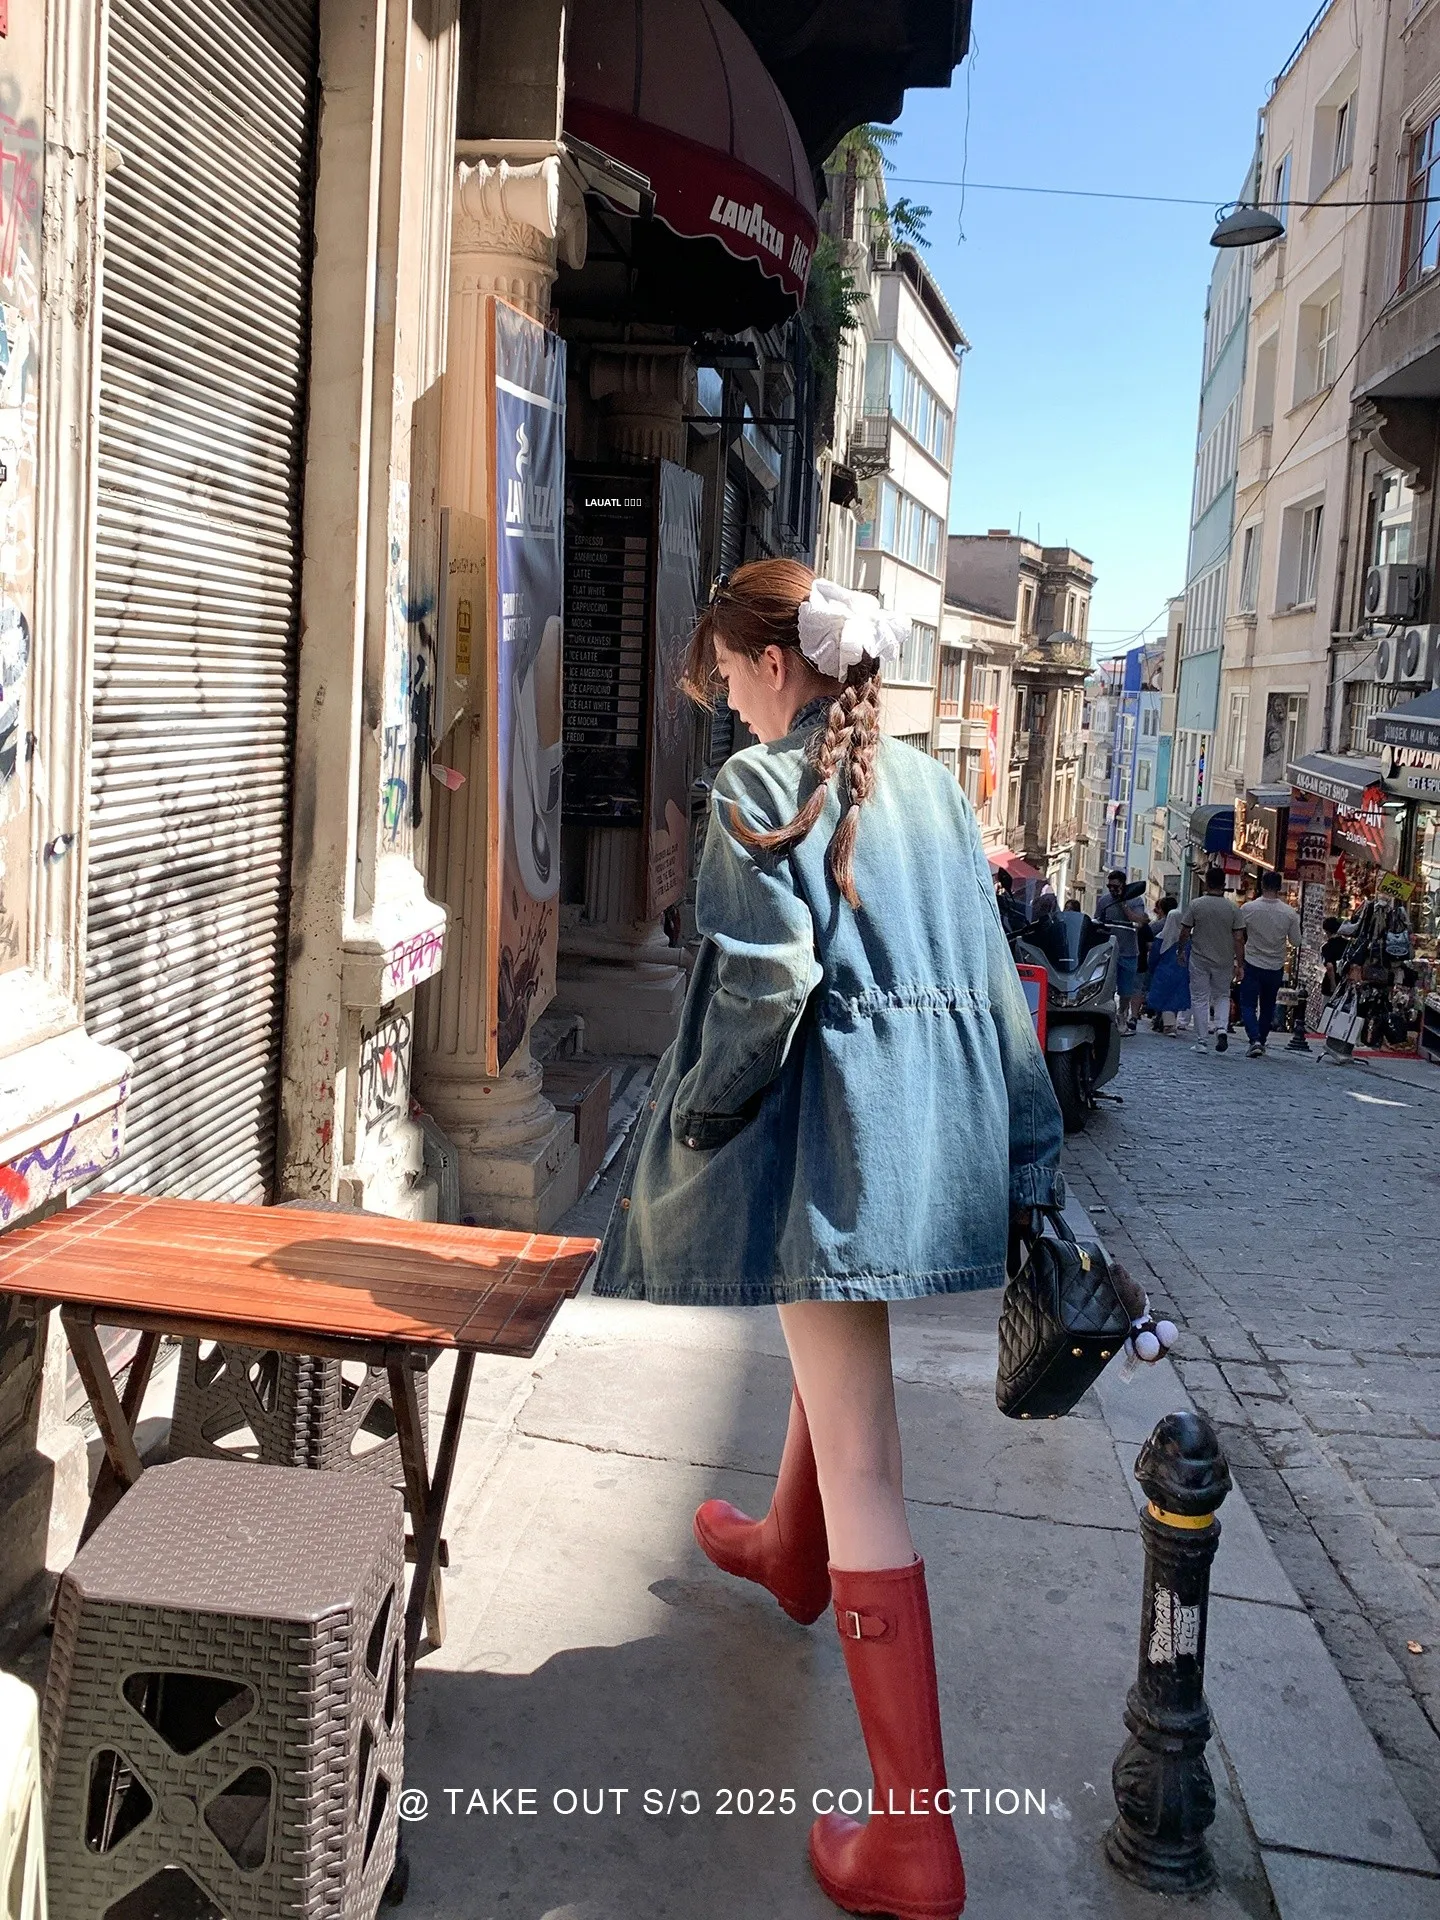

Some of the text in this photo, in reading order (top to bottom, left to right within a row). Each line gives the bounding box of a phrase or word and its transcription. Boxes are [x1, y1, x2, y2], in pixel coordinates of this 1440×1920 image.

[709, 194, 810, 282] LAVAZZA TAKE
[505, 474, 556, 525] LAVAZZA
[574, 534, 604, 546] ESPRESSO
[573, 551, 608, 563] AMERICANO
[573, 569, 592, 579] LATTE
[572, 585, 606, 597] FLAT WHITE
[570, 617, 593, 628] MOCHA
[580, 651, 598, 662] LATTE
[569, 667, 613, 679] ICE AMERICANO
[568, 683, 578, 693] ICE
[567, 699, 611, 711] ICE FLAT WHITE
[567, 716, 598, 727] ICE MOCHA
[566, 732, 585, 742] FREDO
[1319, 780, 1332, 796] GIFT
[1332, 784, 1349, 802] SHOP
[1427, 779, 1440, 793] SPI
[1346, 830, 1367, 847] SOUVENIR
